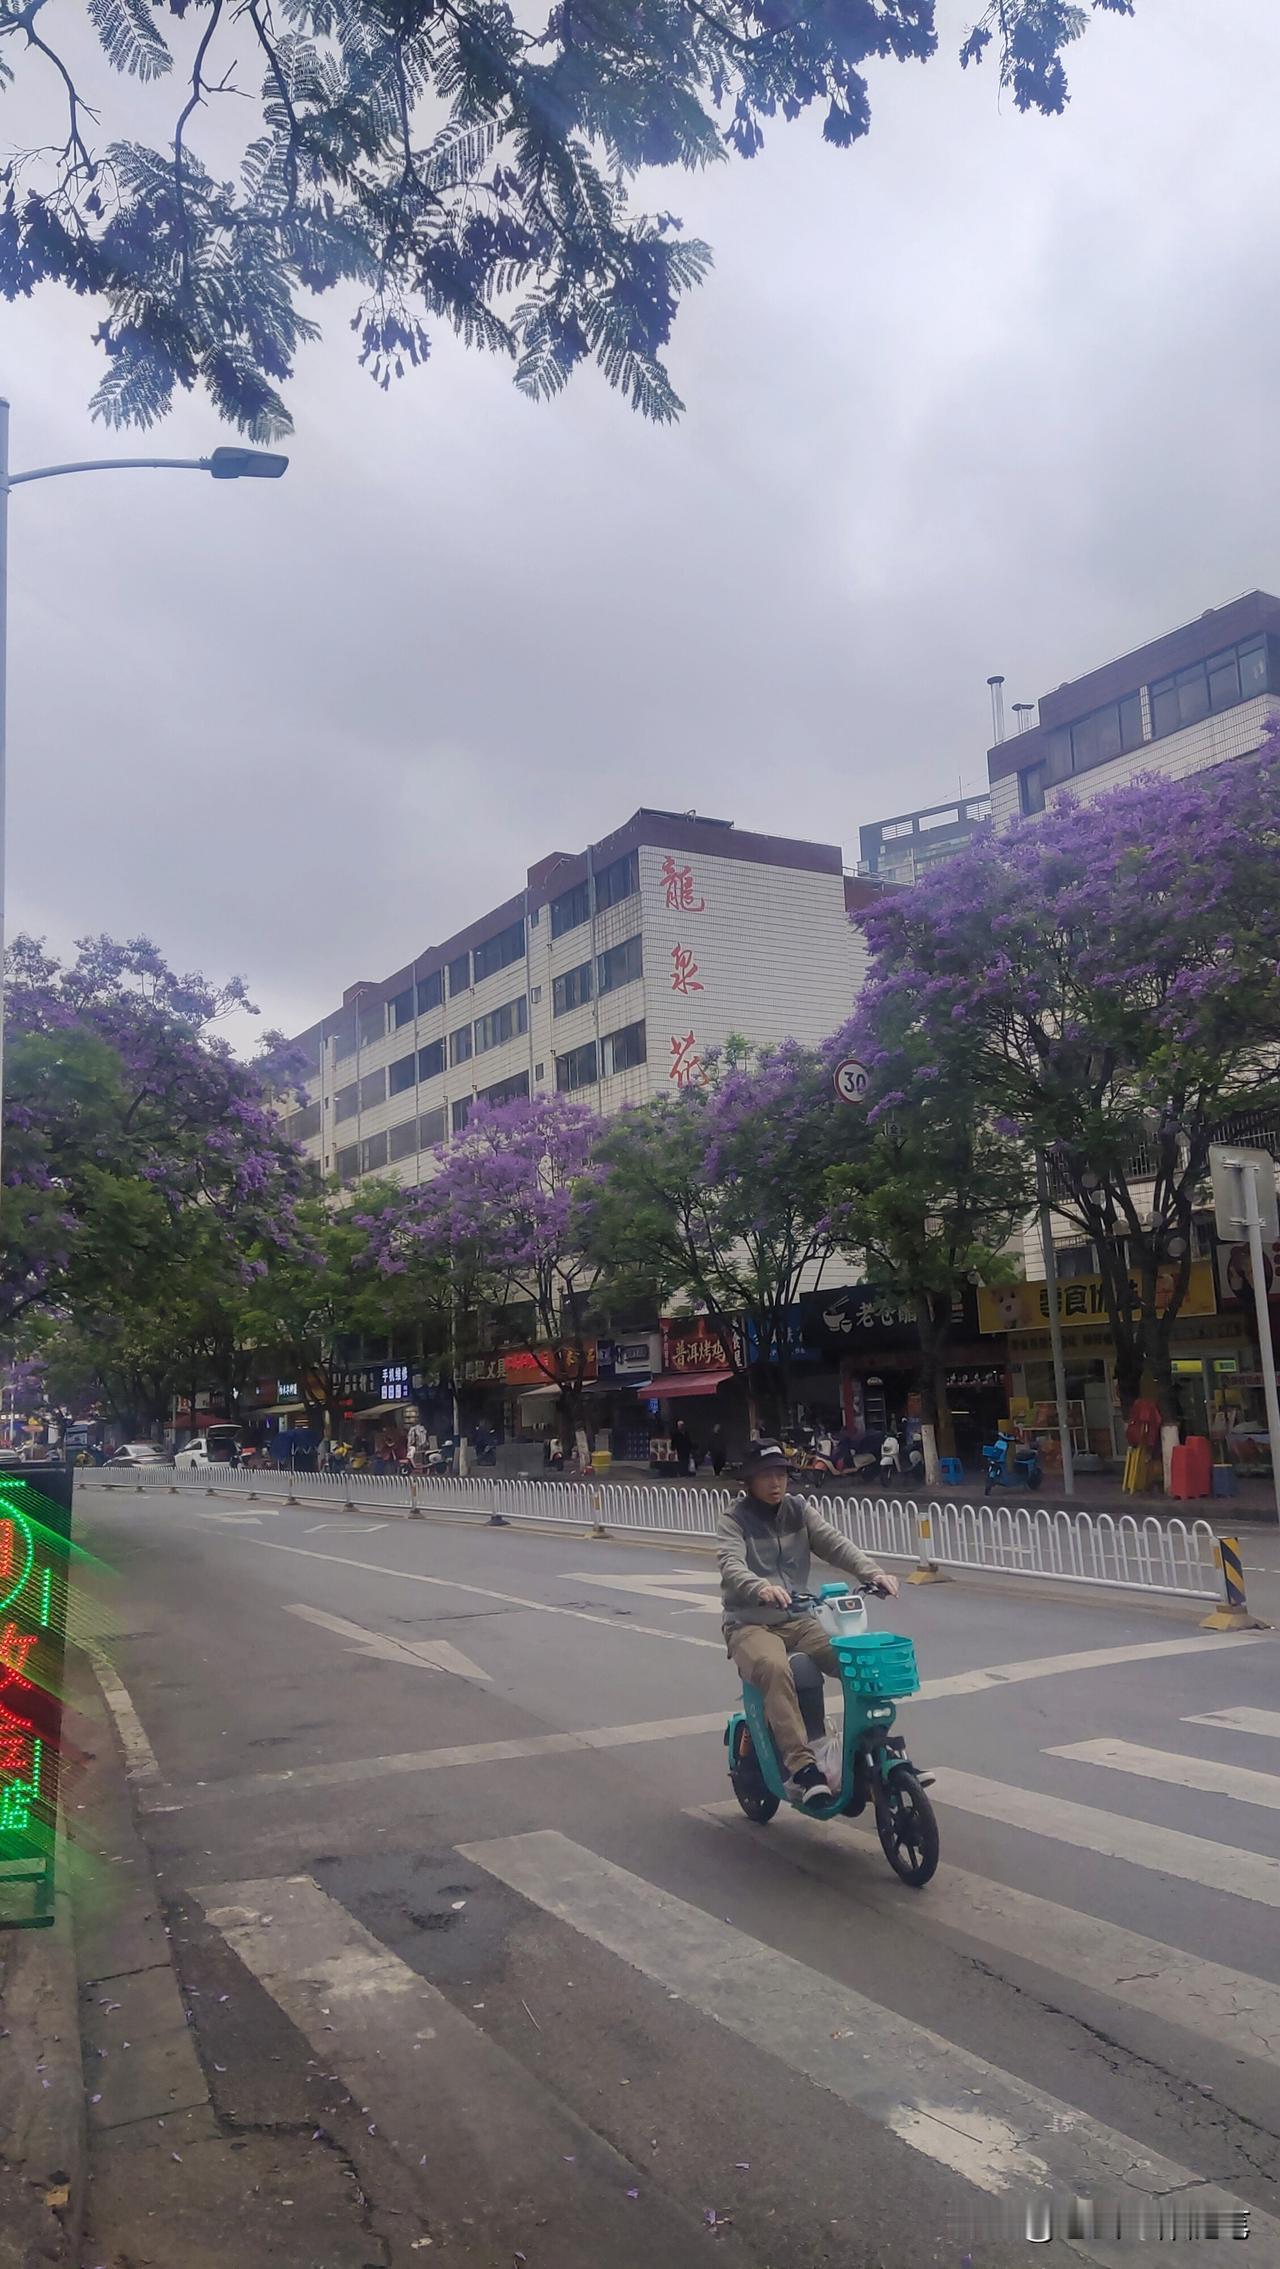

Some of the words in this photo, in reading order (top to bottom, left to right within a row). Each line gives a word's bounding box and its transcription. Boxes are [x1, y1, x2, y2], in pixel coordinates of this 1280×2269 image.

[844, 1071, 866, 1094] 30
[673, 1338, 728, 1369] 普洱烤鸡
[381, 1366, 408, 1384] 手机维修
